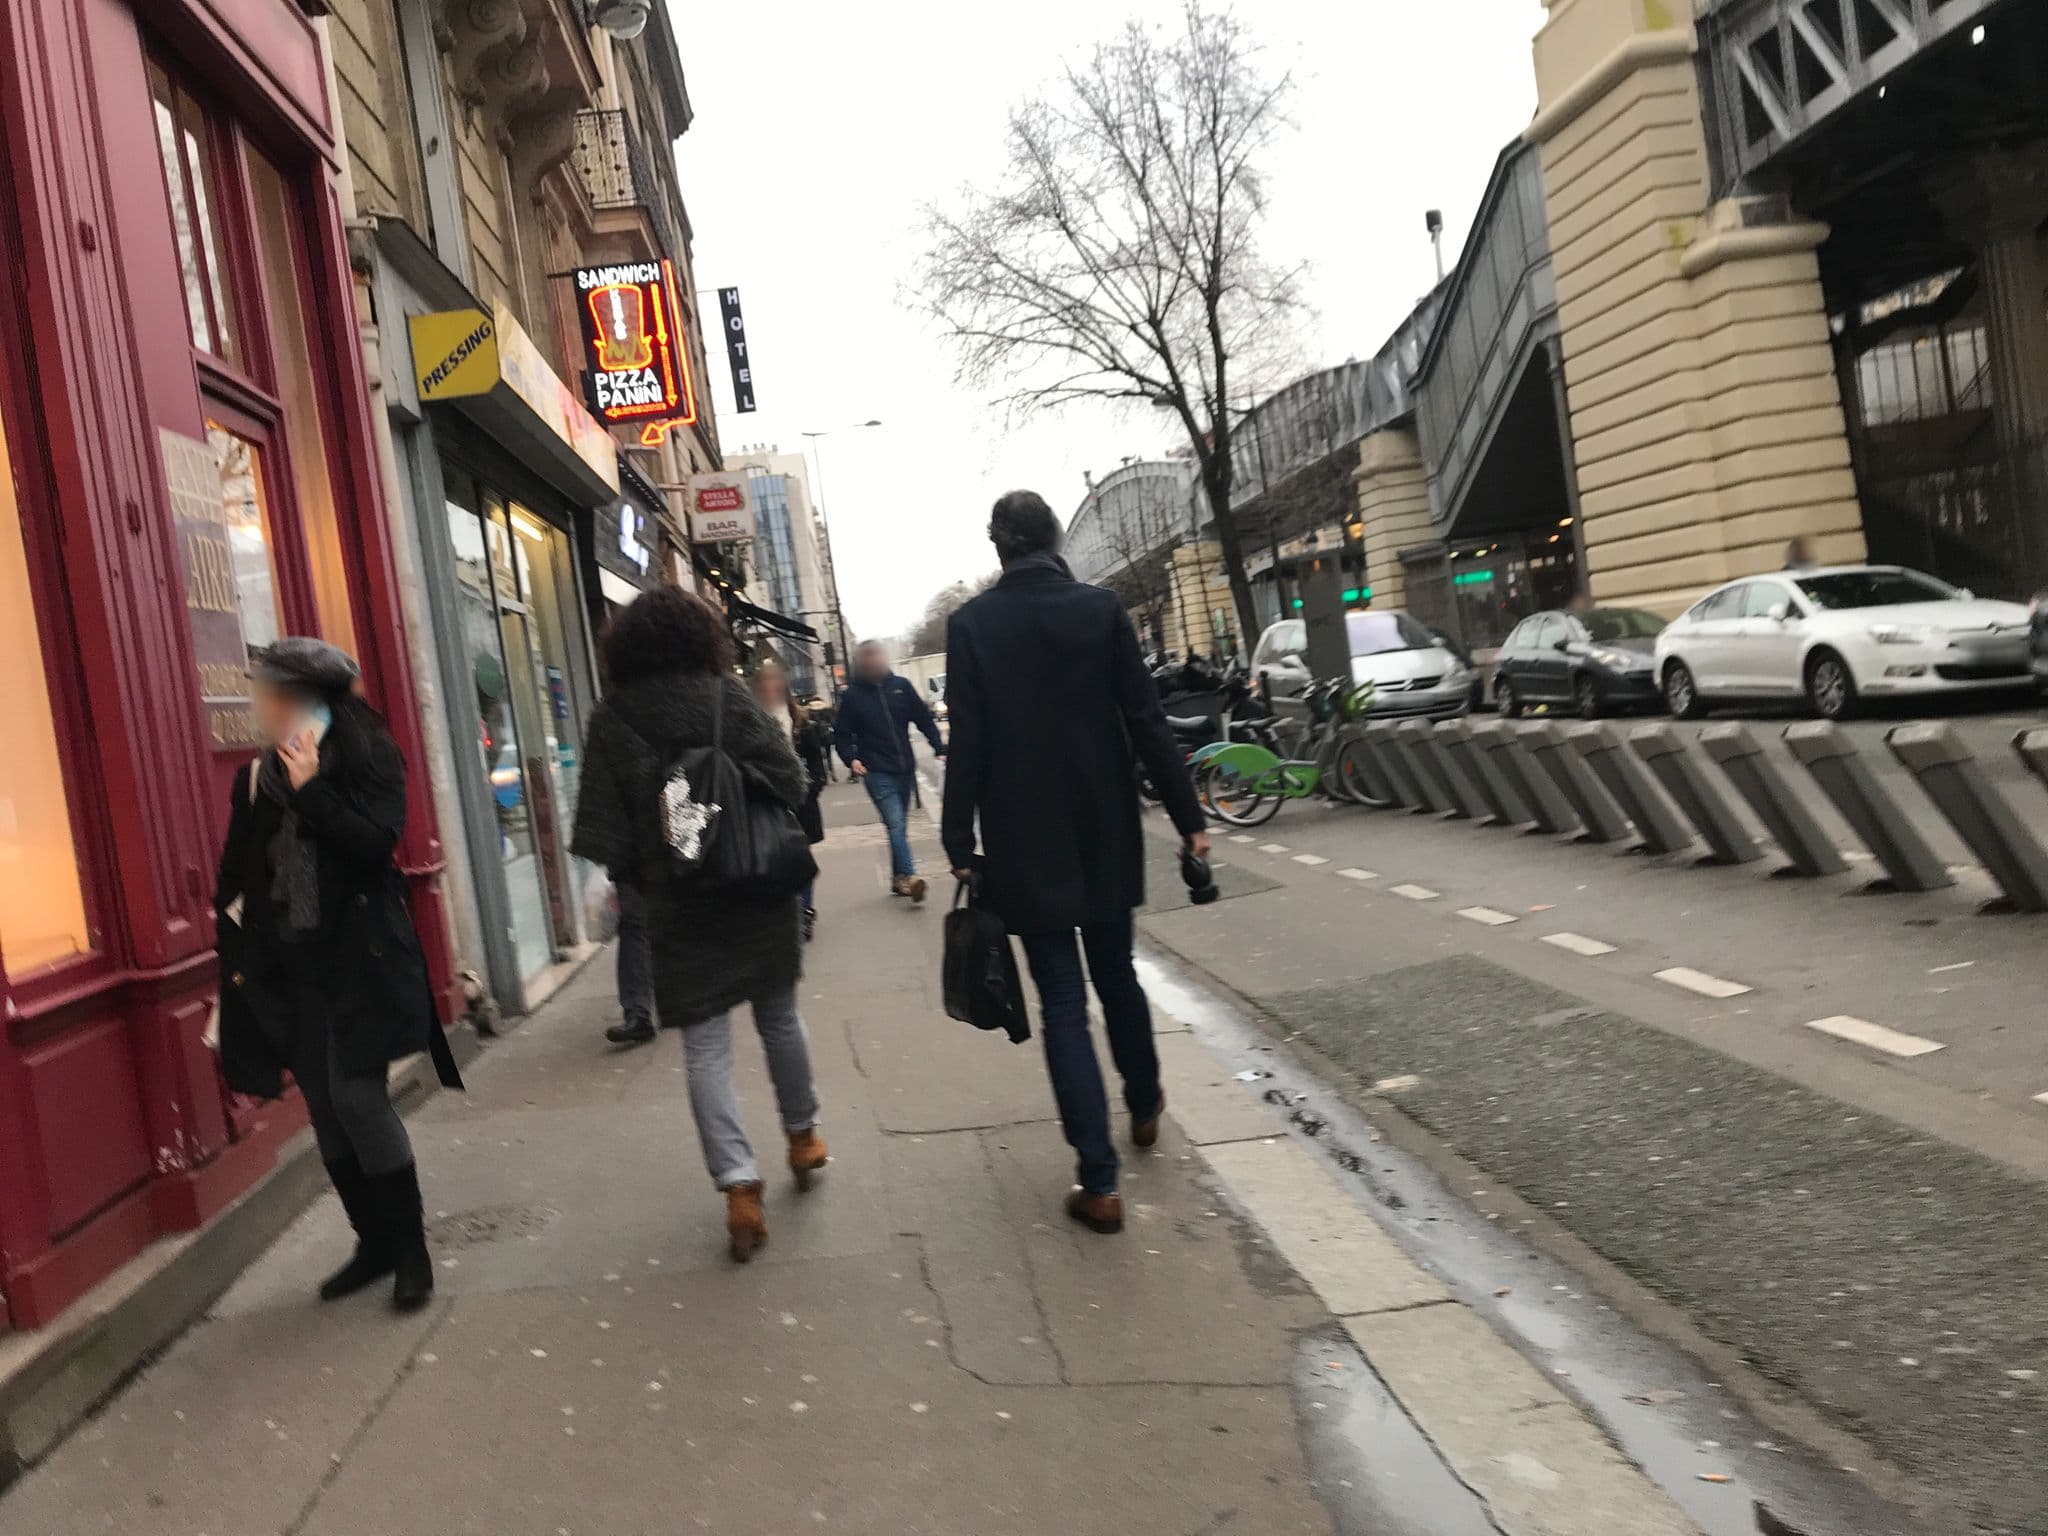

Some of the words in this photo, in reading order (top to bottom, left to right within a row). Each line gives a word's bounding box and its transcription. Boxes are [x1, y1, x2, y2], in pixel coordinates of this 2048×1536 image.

[577, 262, 661, 289] SANDWICH
[422, 321, 492, 394] PRESSING
[726, 289, 755, 409] HOTEL
[594, 367, 659, 391] PIZZA
[597, 384, 663, 409] PANINI
[707, 521, 737, 531] BAR
